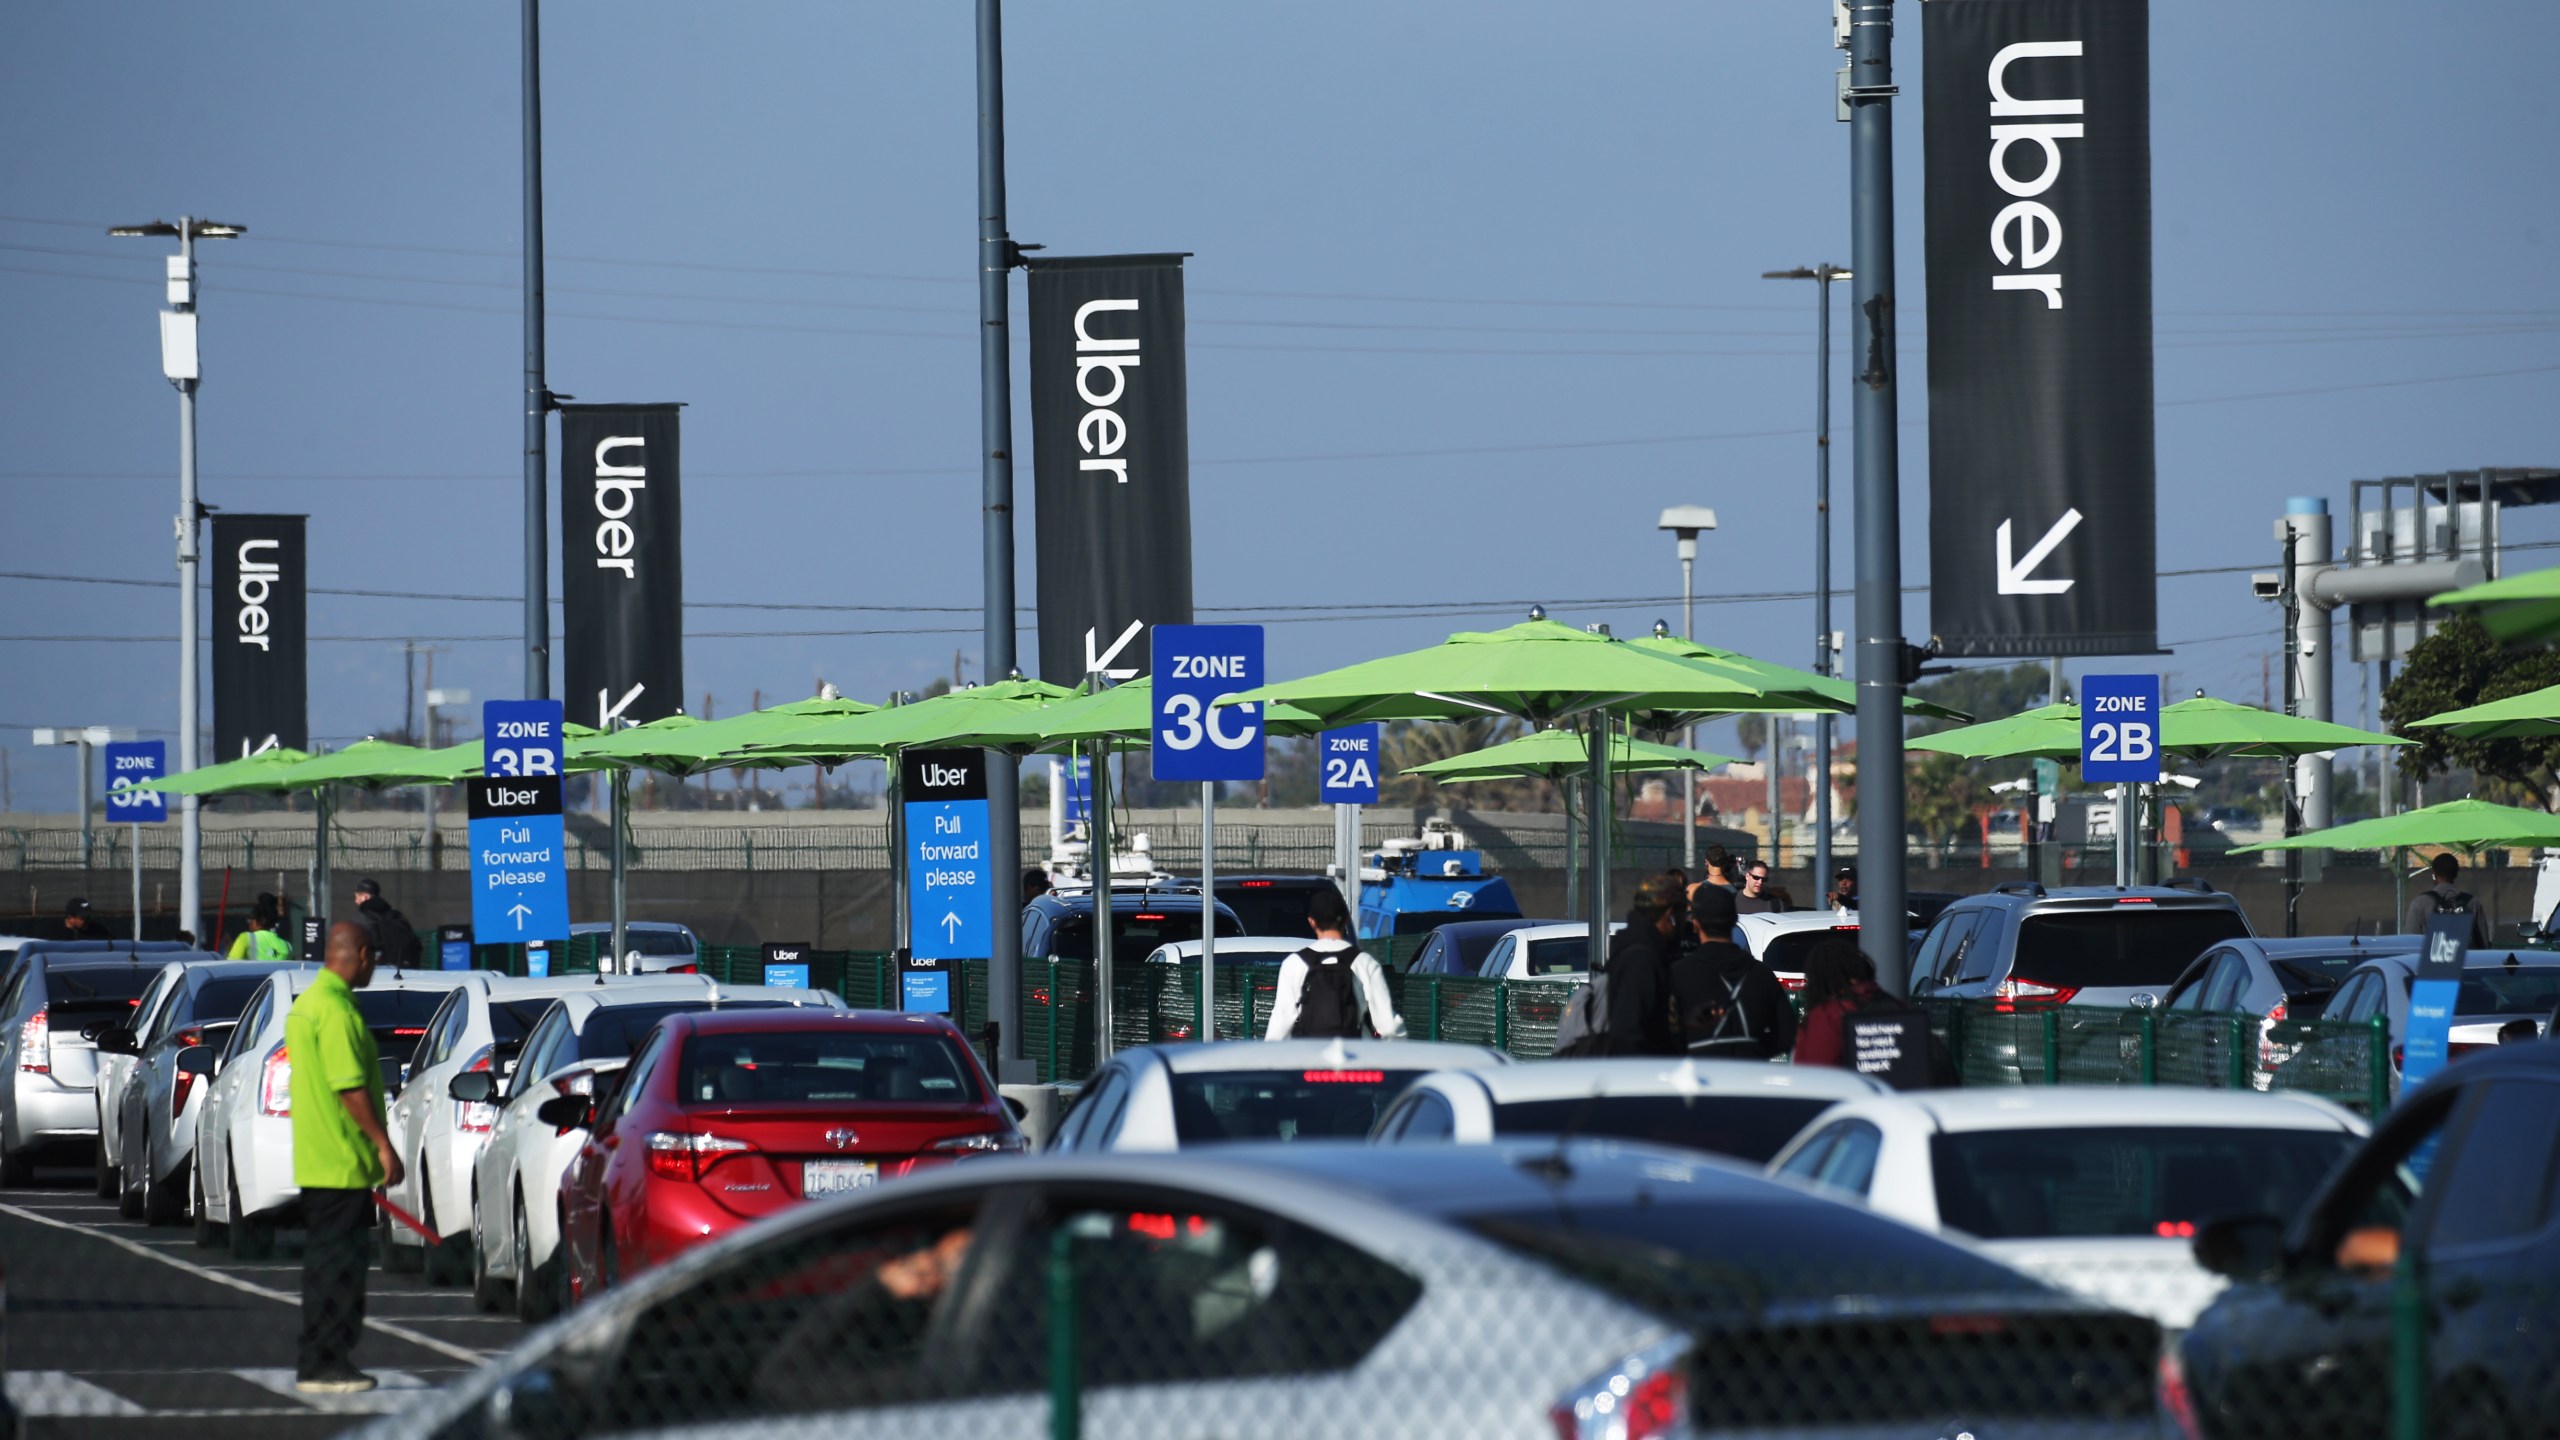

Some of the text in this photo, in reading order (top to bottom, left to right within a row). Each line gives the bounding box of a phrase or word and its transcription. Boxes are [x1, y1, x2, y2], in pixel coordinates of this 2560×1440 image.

[1988, 41, 2083, 309] Uber
[1074, 298, 1140, 484] Uber
[594, 436, 646, 579] Uber
[238, 539, 280, 652] Uber
[1172, 655, 1246, 679] ZONE
[2095, 696, 2147, 712] ZONE
[497, 721, 550, 738] ZONE
[1161, 692, 1257, 751] 3C
[1330, 738, 1369, 752] ZONE
[2089, 722, 2153, 762] 2B
[115, 756, 155, 770] ZONE
[1326, 758, 1374, 788] 2A
[921, 763, 968, 788] Uber
[486, 787, 539, 808] Uber
[935, 815, 961, 835] Pull
[501, 828, 531, 845] Pull
[483, 847, 550, 866] forward
[920, 840, 979, 861] forward
[488, 869, 546, 890] please
[926, 866, 976, 890] please
[773, 950, 799, 961] Uber
[2429, 931, 2460, 963] Uber
